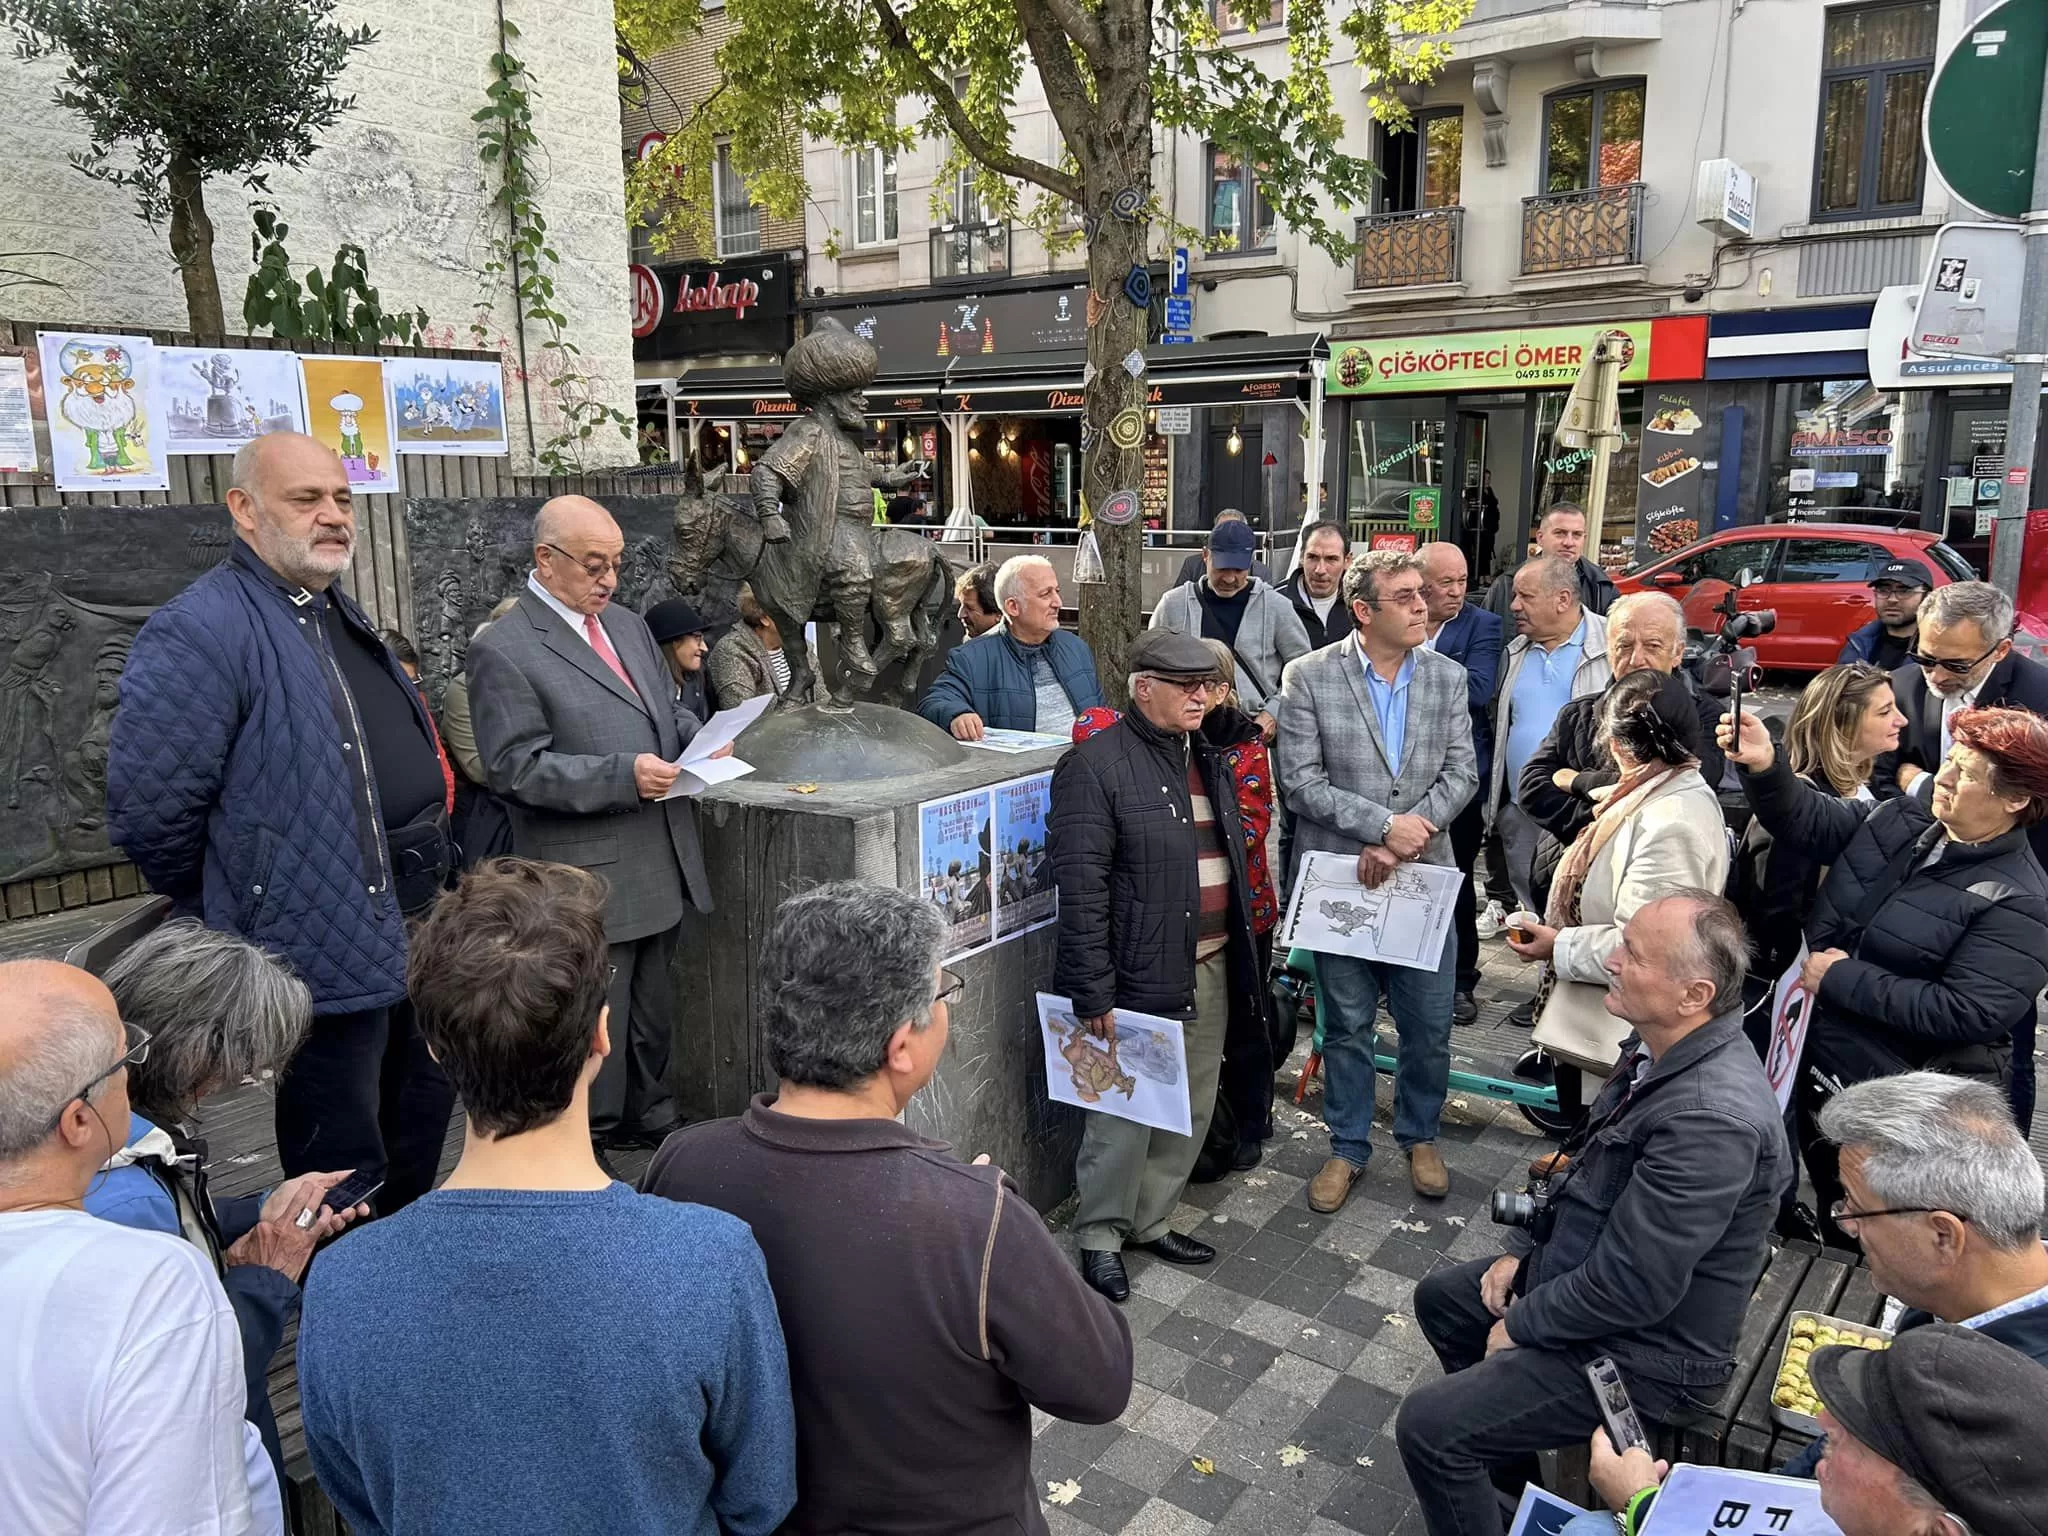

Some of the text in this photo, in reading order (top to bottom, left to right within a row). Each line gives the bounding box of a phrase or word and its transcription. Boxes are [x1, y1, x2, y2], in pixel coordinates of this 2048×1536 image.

[1174, 255, 1186, 288] P
[674, 271, 759, 320] kebap
[1378, 344, 1582, 380] ÇİĞKÖFTECİ ÖMER
[1908, 363, 1999, 373] Assurances
[1516, 370, 1540, 379] 0493
[1543, 368, 1554, 378] 85
[1557, 368, 1568, 377] 77
[687, 399, 797, 416] K Pizzeria
[955, 395, 972, 411] K
[1658, 393, 1691, 407] Falafel
[349, 459, 356, 470] 1
[1367, 439, 1429, 477] Vegetarian
[369, 471, 375, 480] 3
